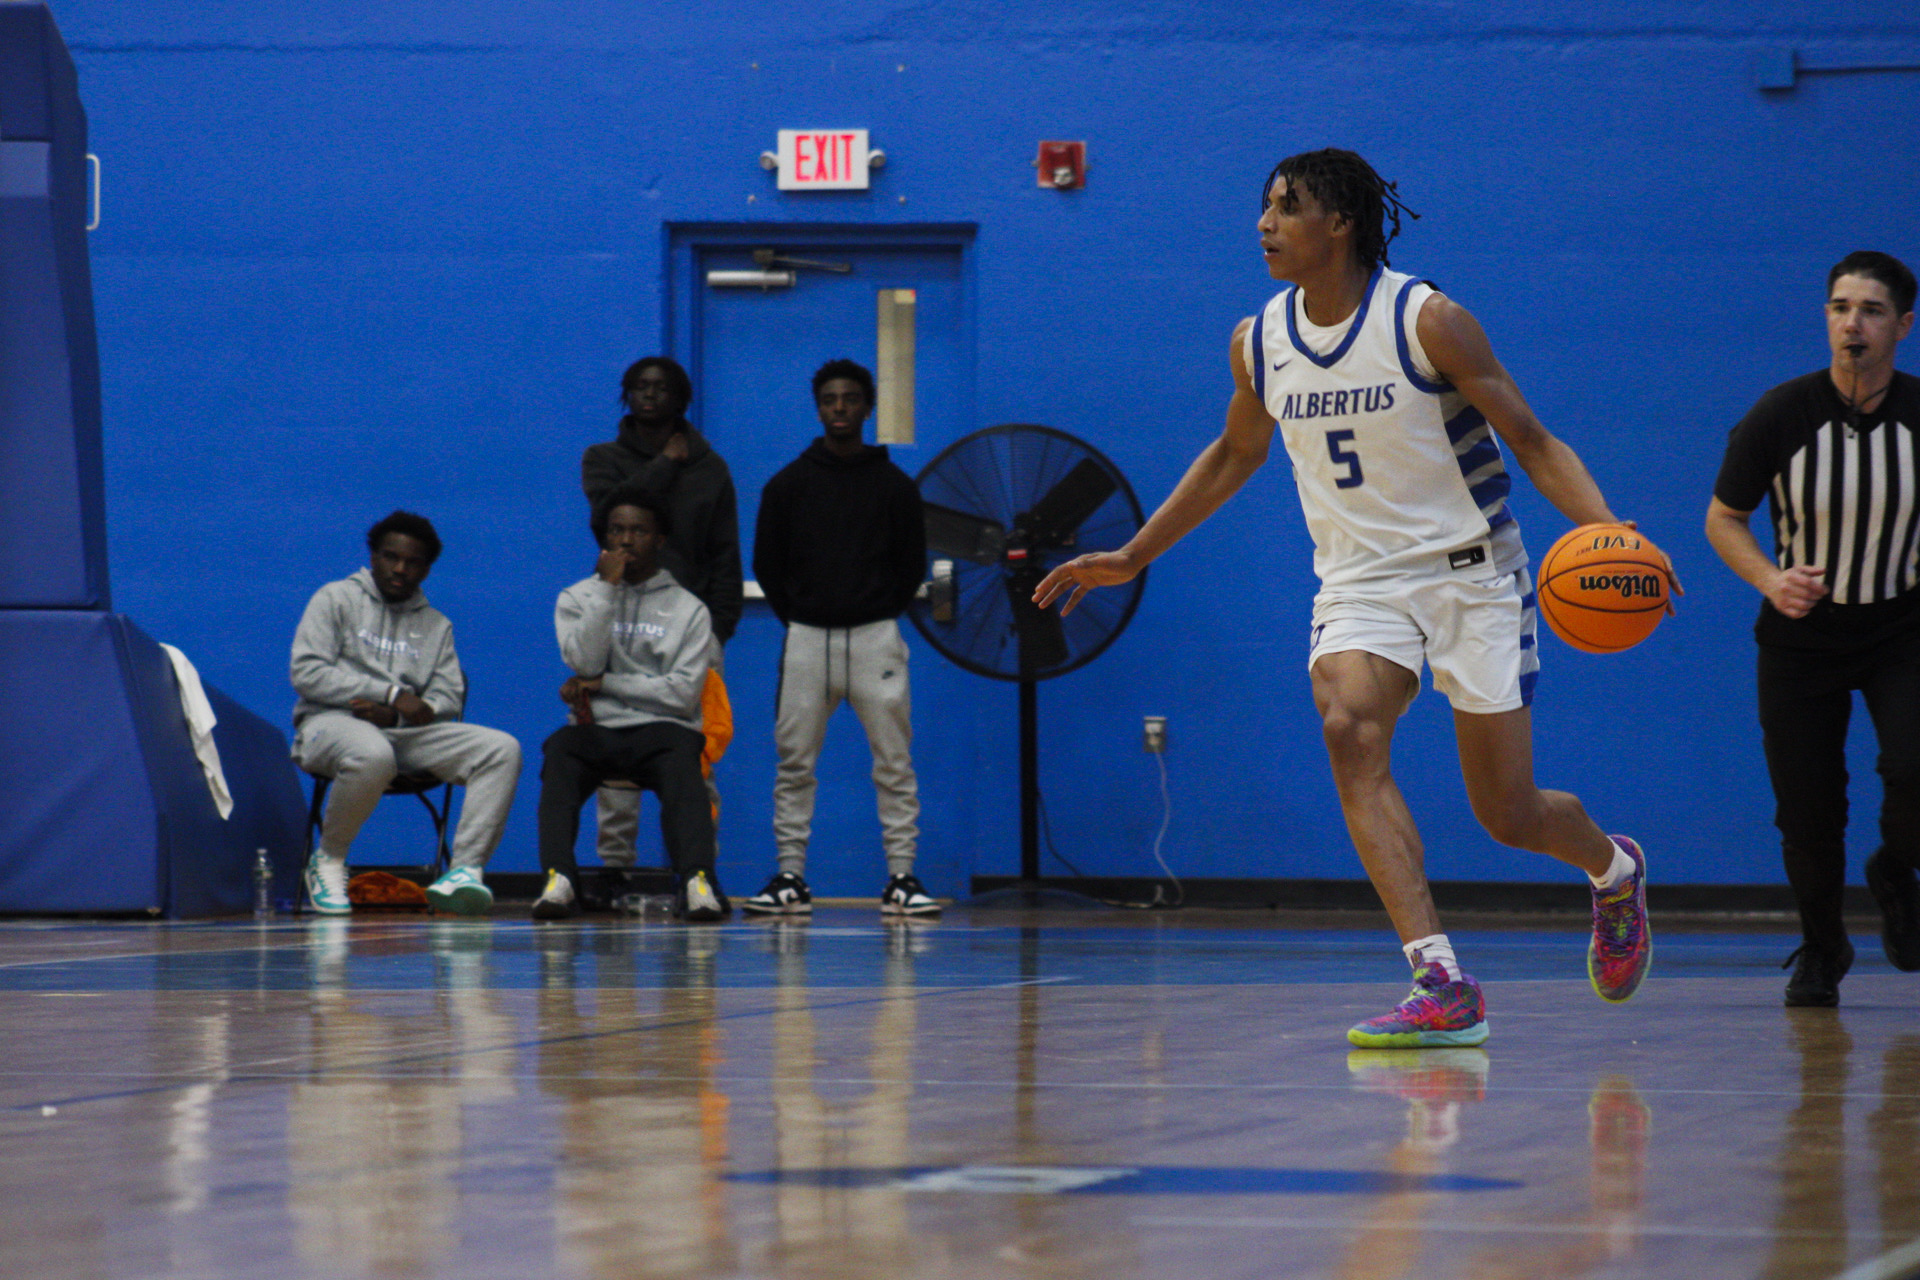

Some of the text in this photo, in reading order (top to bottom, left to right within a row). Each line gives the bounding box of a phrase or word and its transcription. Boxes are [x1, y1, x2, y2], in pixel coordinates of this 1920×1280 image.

[795, 134, 856, 182] EXIT
[1281, 382, 1396, 420] ALBERTUS
[1325, 429, 1364, 490] 5
[1593, 535, 1641, 551] EVO
[1579, 574, 1661, 598] Wilson
